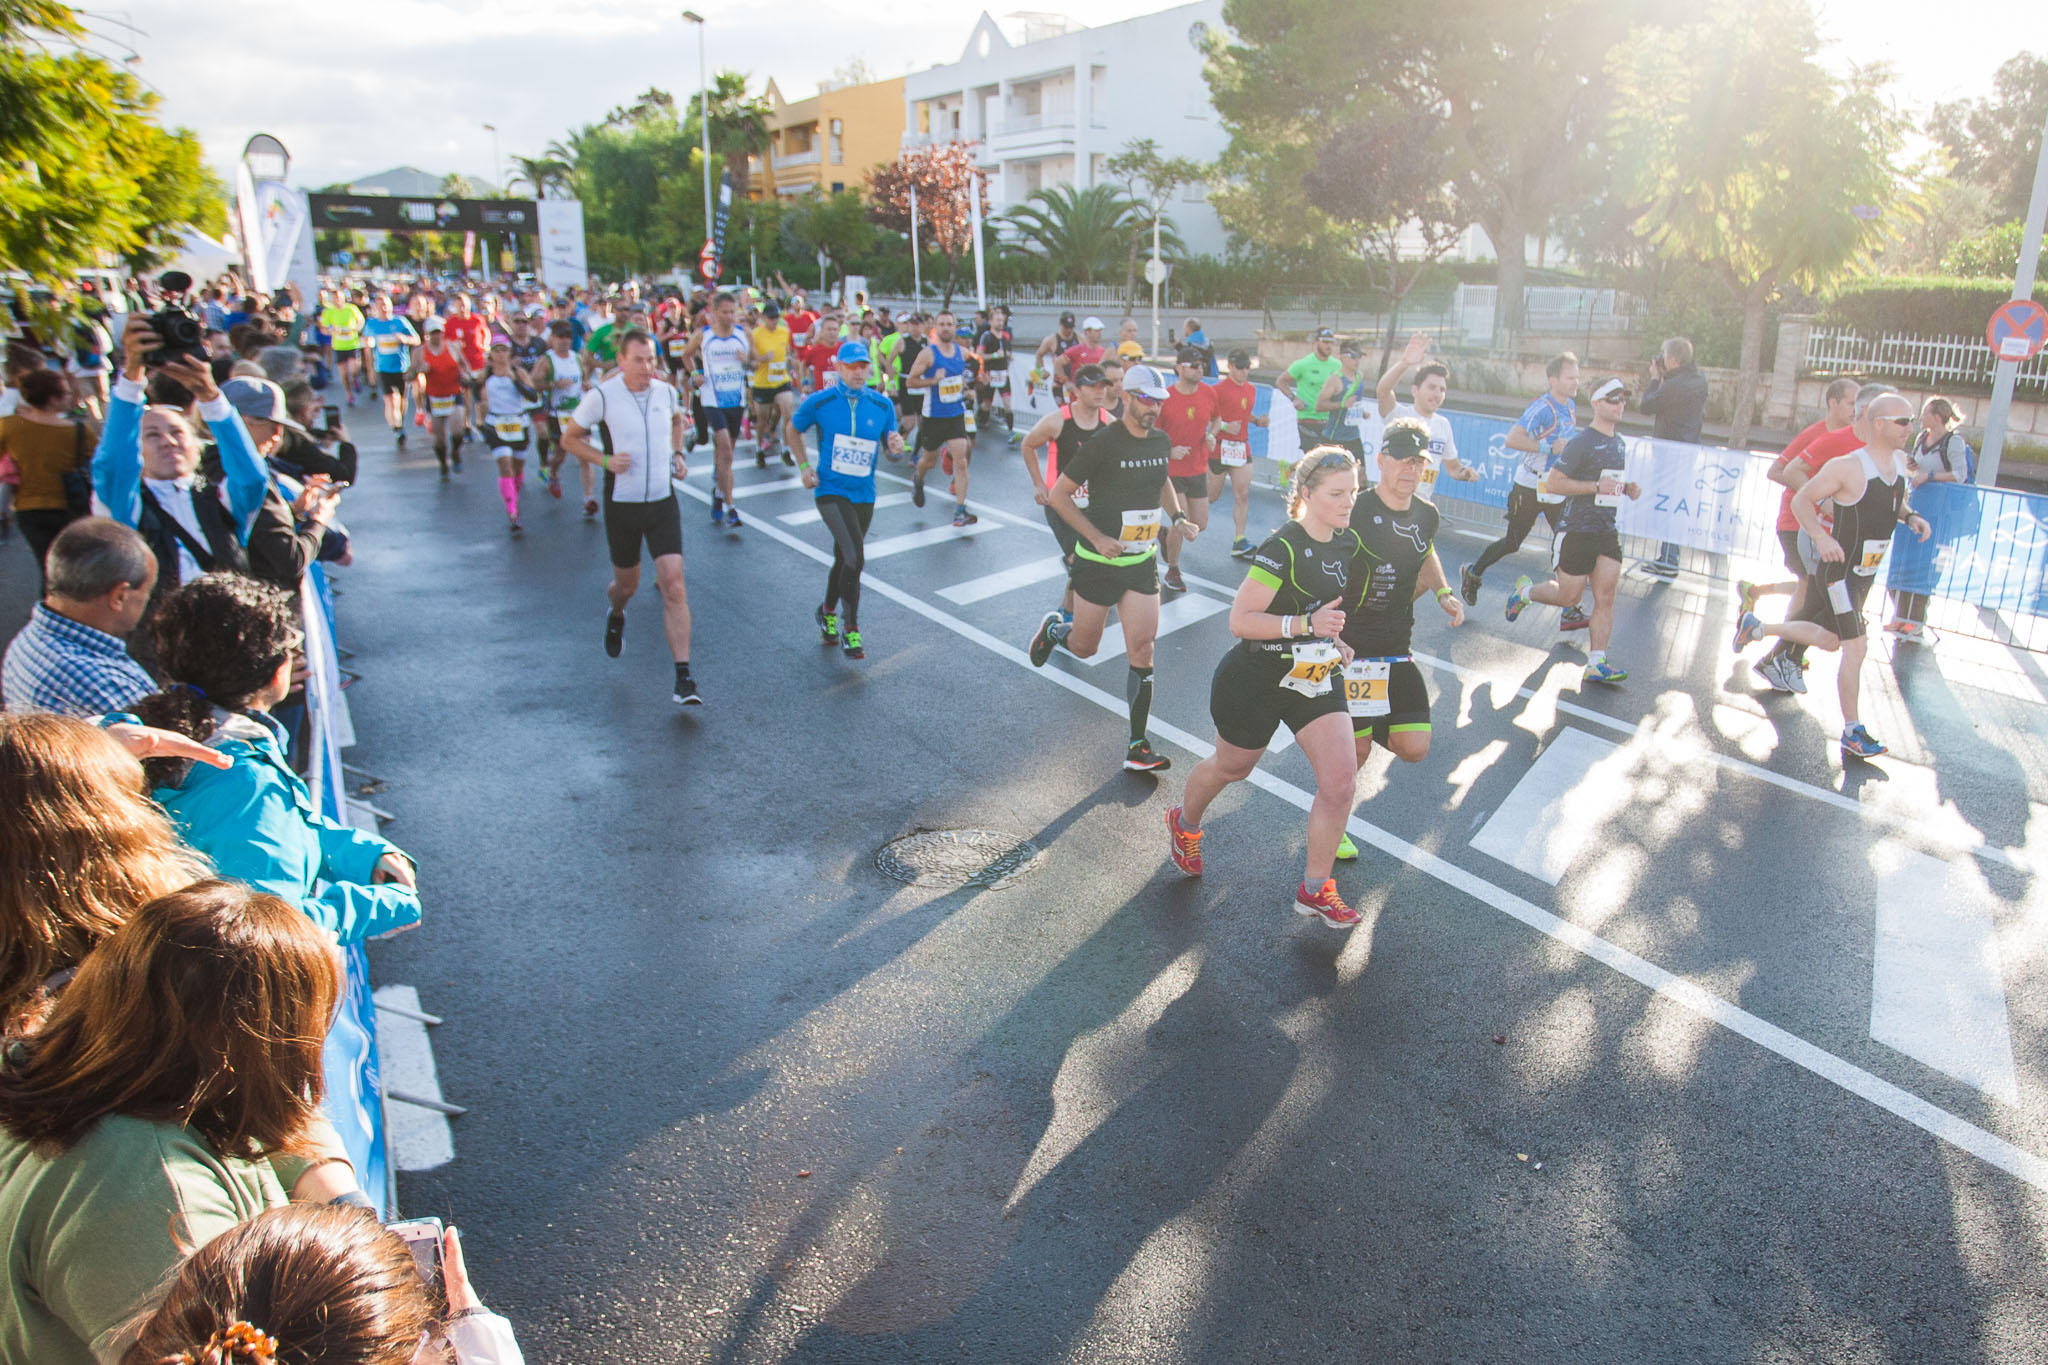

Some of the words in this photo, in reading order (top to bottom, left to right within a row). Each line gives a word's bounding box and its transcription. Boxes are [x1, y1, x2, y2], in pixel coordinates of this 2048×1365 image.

[835, 447, 870, 465] 2305
[1460, 459, 1513, 484] ZAFi
[1134, 526, 1152, 541] 21
[1688, 527, 1730, 541] HOTELS
[1262, 642, 1283, 652] URG
[1348, 681, 1371, 699] 92
